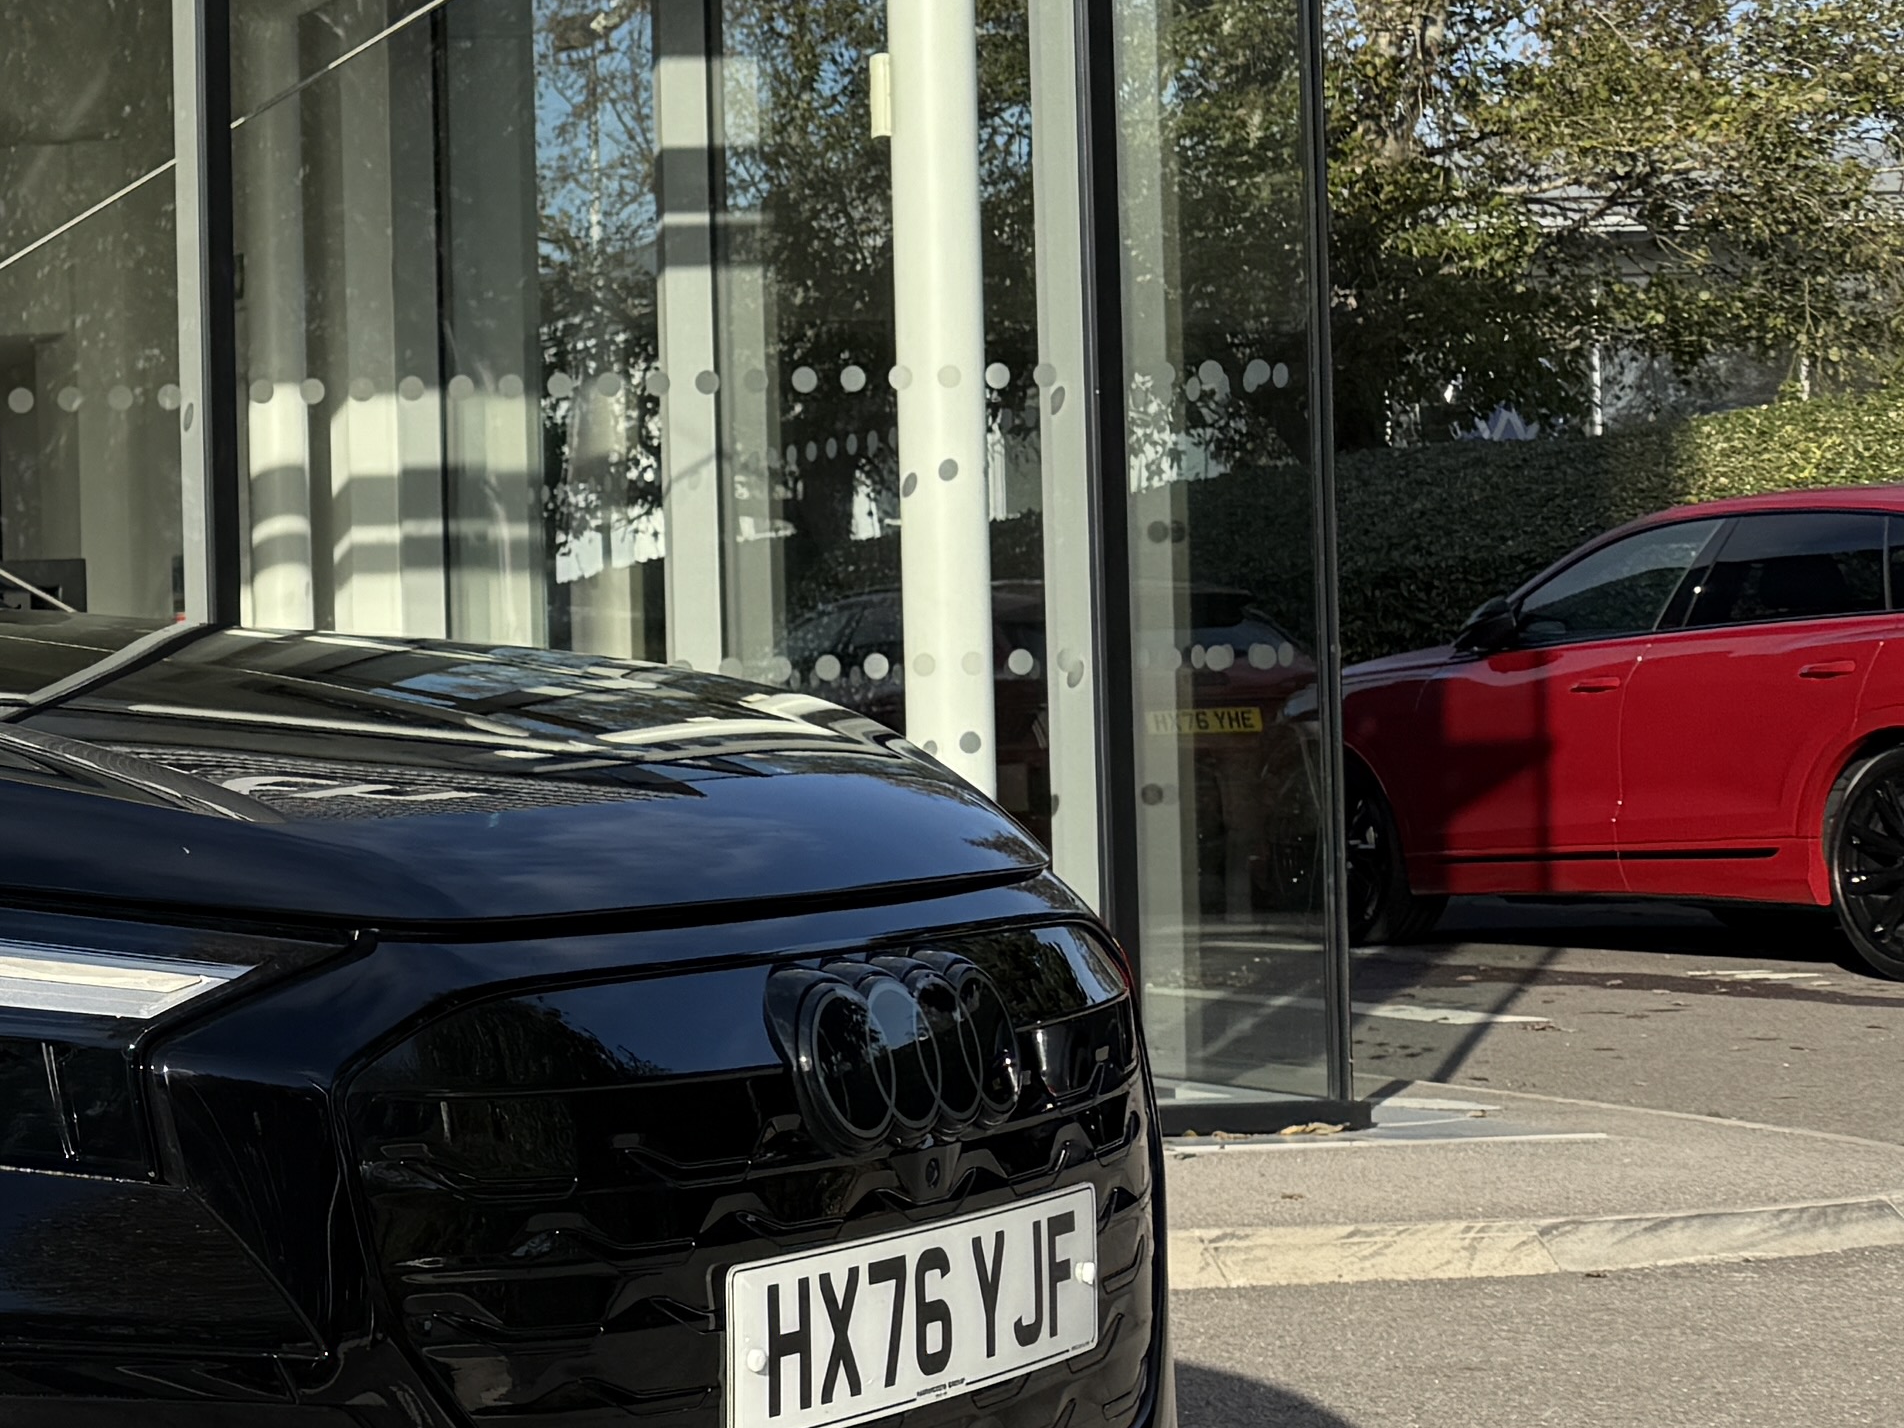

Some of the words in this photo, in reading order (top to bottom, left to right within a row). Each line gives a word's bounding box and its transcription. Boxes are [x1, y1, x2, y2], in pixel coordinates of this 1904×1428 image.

[1154, 711, 1210, 732] HX76
[1213, 709, 1254, 729] YHE
[768, 1247, 952, 1417] HX76
[972, 1211, 1075, 1358] YJF
